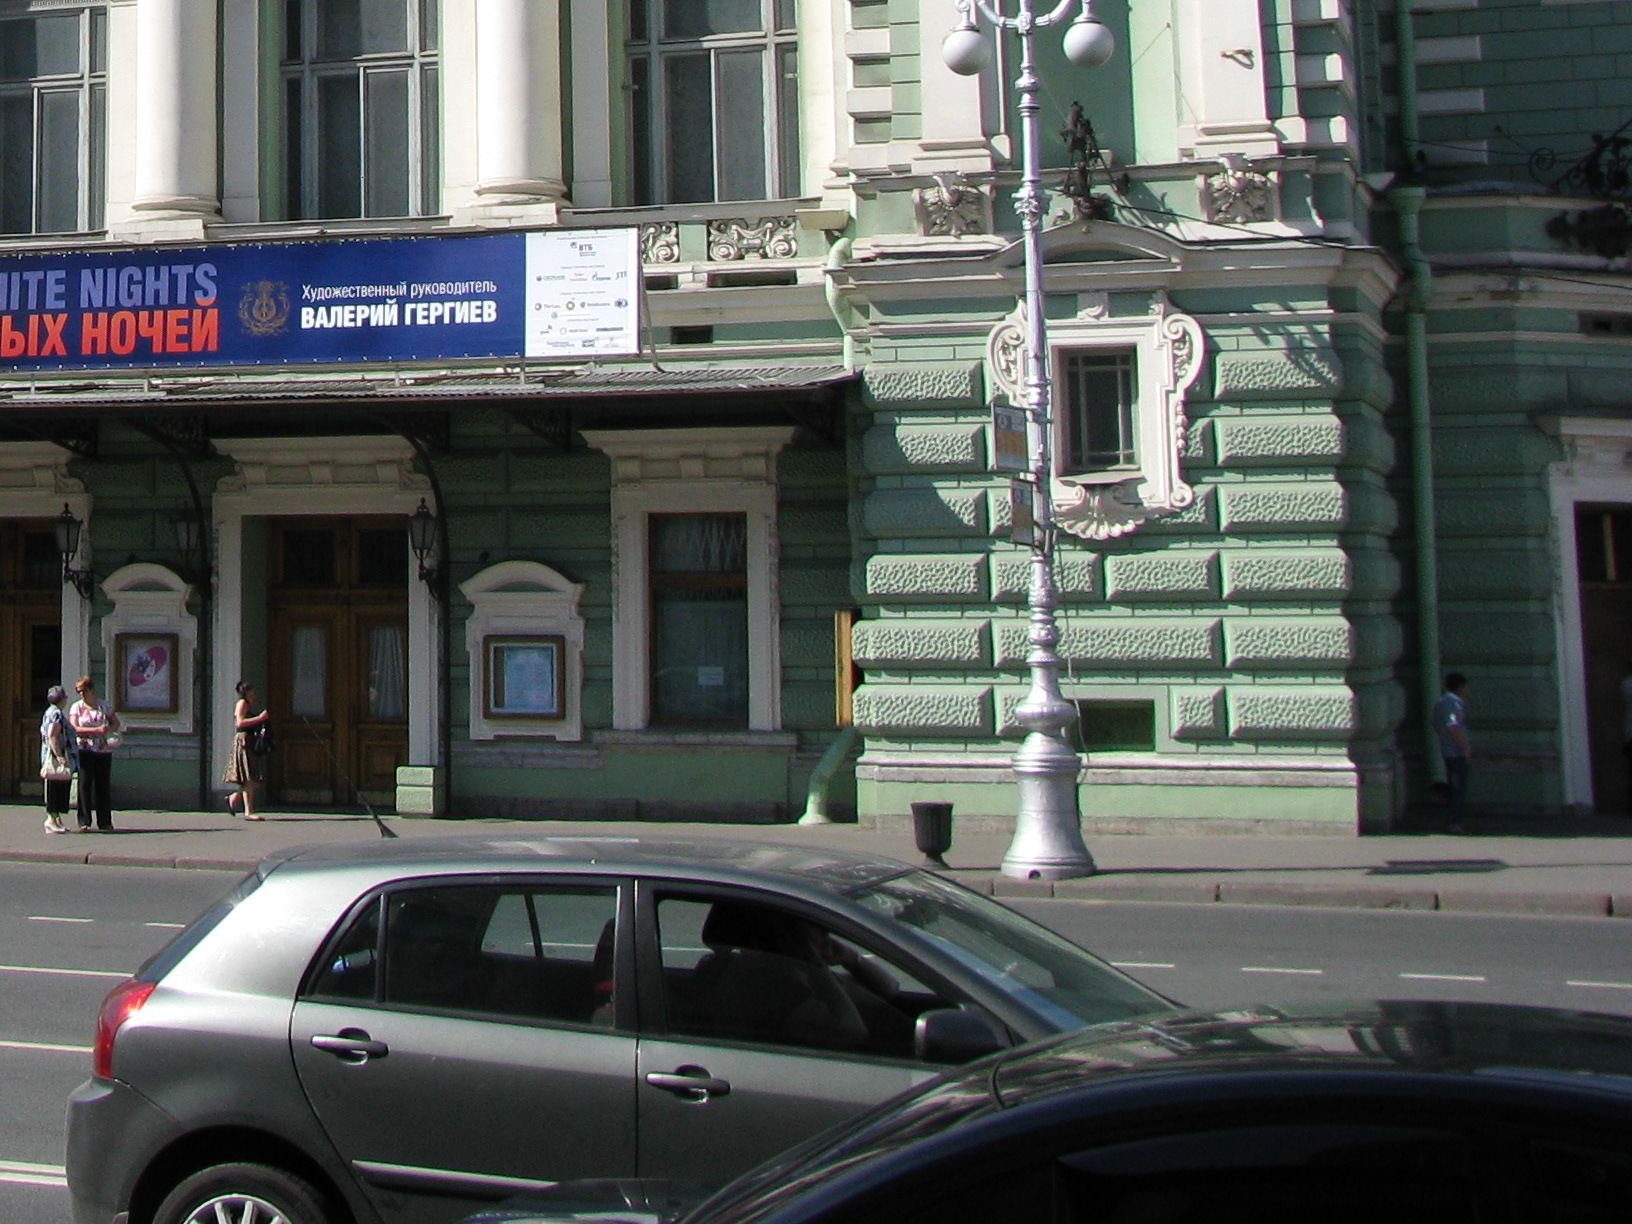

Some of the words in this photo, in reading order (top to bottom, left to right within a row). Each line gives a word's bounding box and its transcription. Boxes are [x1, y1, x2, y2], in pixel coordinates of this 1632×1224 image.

[80, 262, 219, 308] NIGHTS
[301, 280, 408, 302] Художественный
[411, 279, 497, 299] руководитель
[81, 297, 220, 355] НОЧЕЙ
[300, 298, 399, 330] ВАЛЕРИЙ
[404, 299, 497, 327] ГЕРГИЕВ
